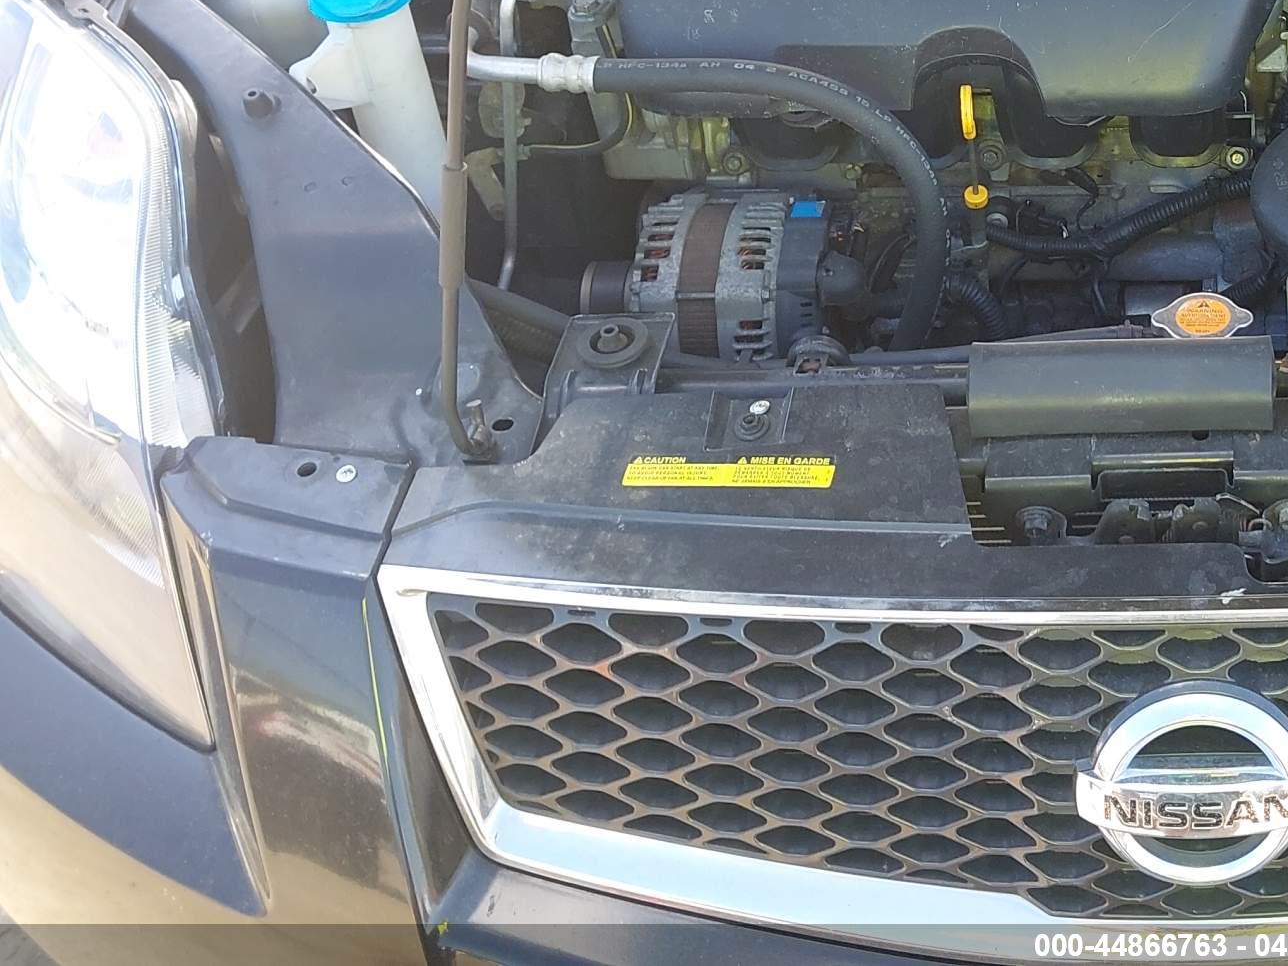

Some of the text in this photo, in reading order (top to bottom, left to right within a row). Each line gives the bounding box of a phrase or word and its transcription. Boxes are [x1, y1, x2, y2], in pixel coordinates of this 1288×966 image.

[643, 456, 688, 464] CAUTION
[750, 457, 831, 465] MISE EN GARDE
